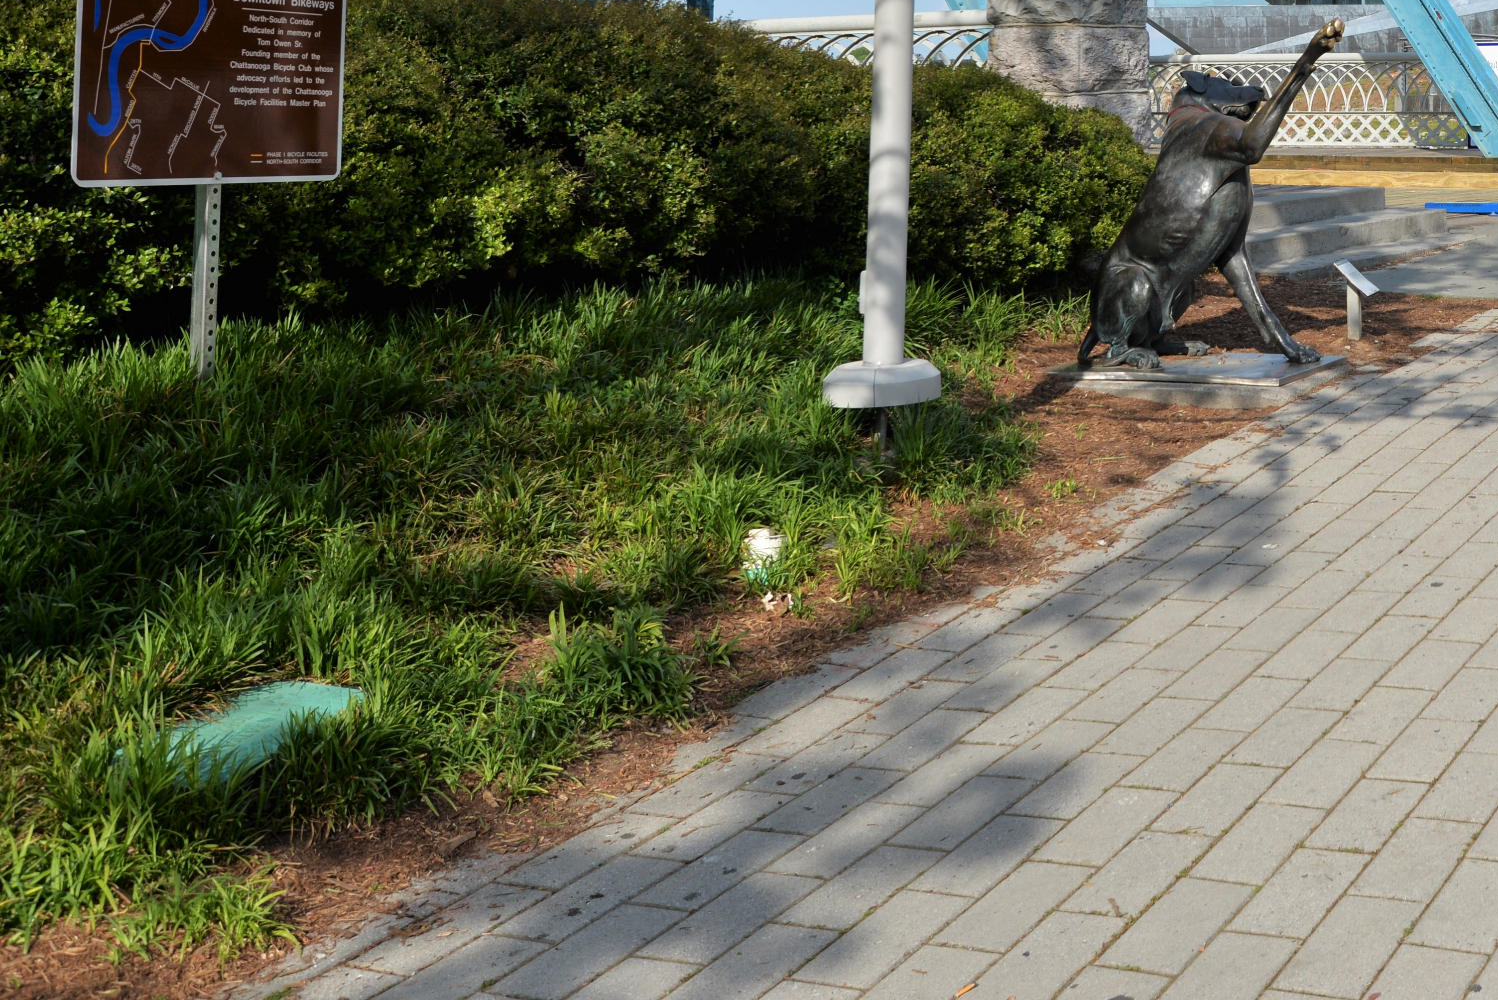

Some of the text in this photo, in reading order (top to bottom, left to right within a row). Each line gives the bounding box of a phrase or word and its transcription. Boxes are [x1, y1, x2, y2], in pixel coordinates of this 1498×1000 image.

[249, 13, 315, 26] North-South Corridor
[243, 25, 321, 38] Dedicated in memory of
[257, 38, 271, 46] Tom
[273, 39, 291, 47] Owen
[241, 48, 271, 59] Founding
[273, 51, 299, 59] member
[301, 52, 308, 60] of
[229, 60, 334, 73] Chattanooga Bicycle Club whose
[236, 74, 267, 83] advocacy
[269, 75, 291, 83] efforts
[293, 76, 304, 84] led
[315, 77, 325, 85] the
[229, 86, 270, 96] development
[282, 87, 293, 95] the
[294, 87, 333, 97] Chattanooga
[233, 97, 327, 107] Bicycle Facilities Master Plan
